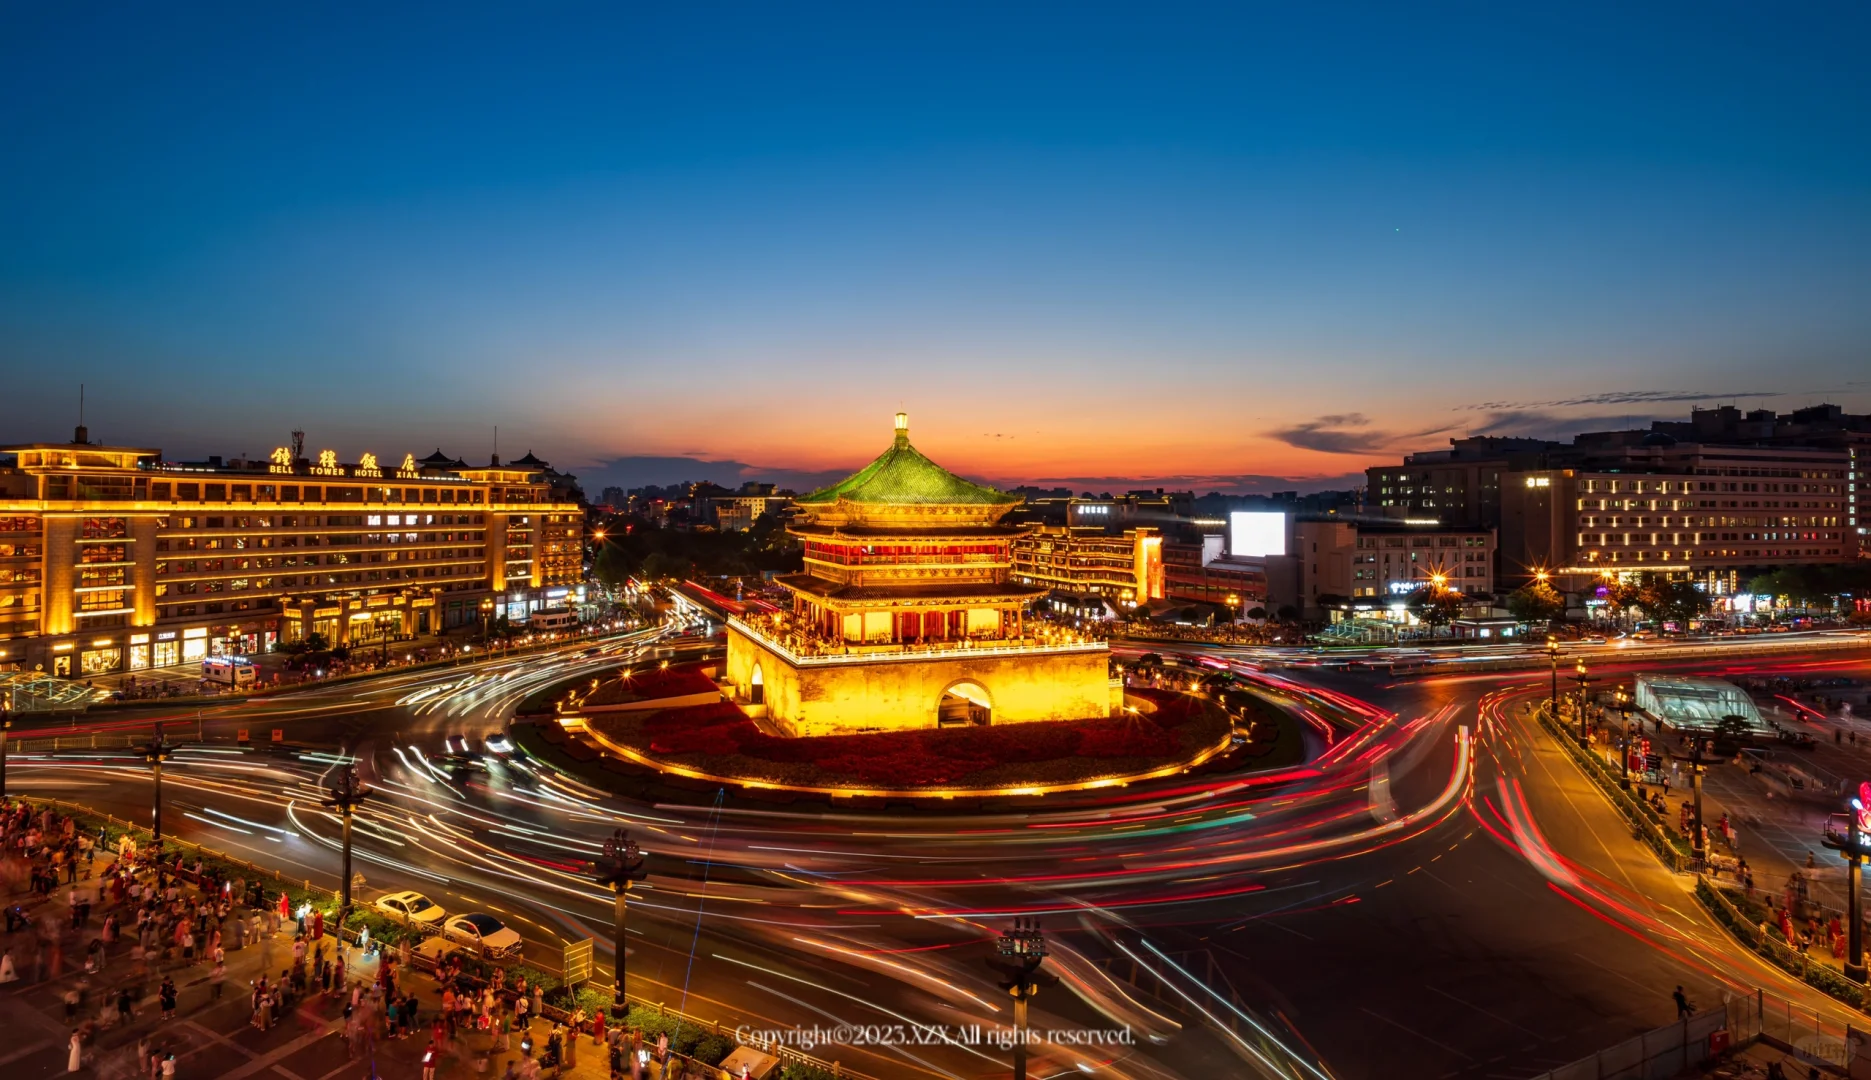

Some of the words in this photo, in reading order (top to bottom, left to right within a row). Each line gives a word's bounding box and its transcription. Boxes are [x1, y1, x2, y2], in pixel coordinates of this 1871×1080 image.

[269, 465, 294, 474] BELL
[309, 467, 345, 476] TOWER
[354, 469, 383, 478] HOTEL
[396, 471, 419, 479] XIAN
